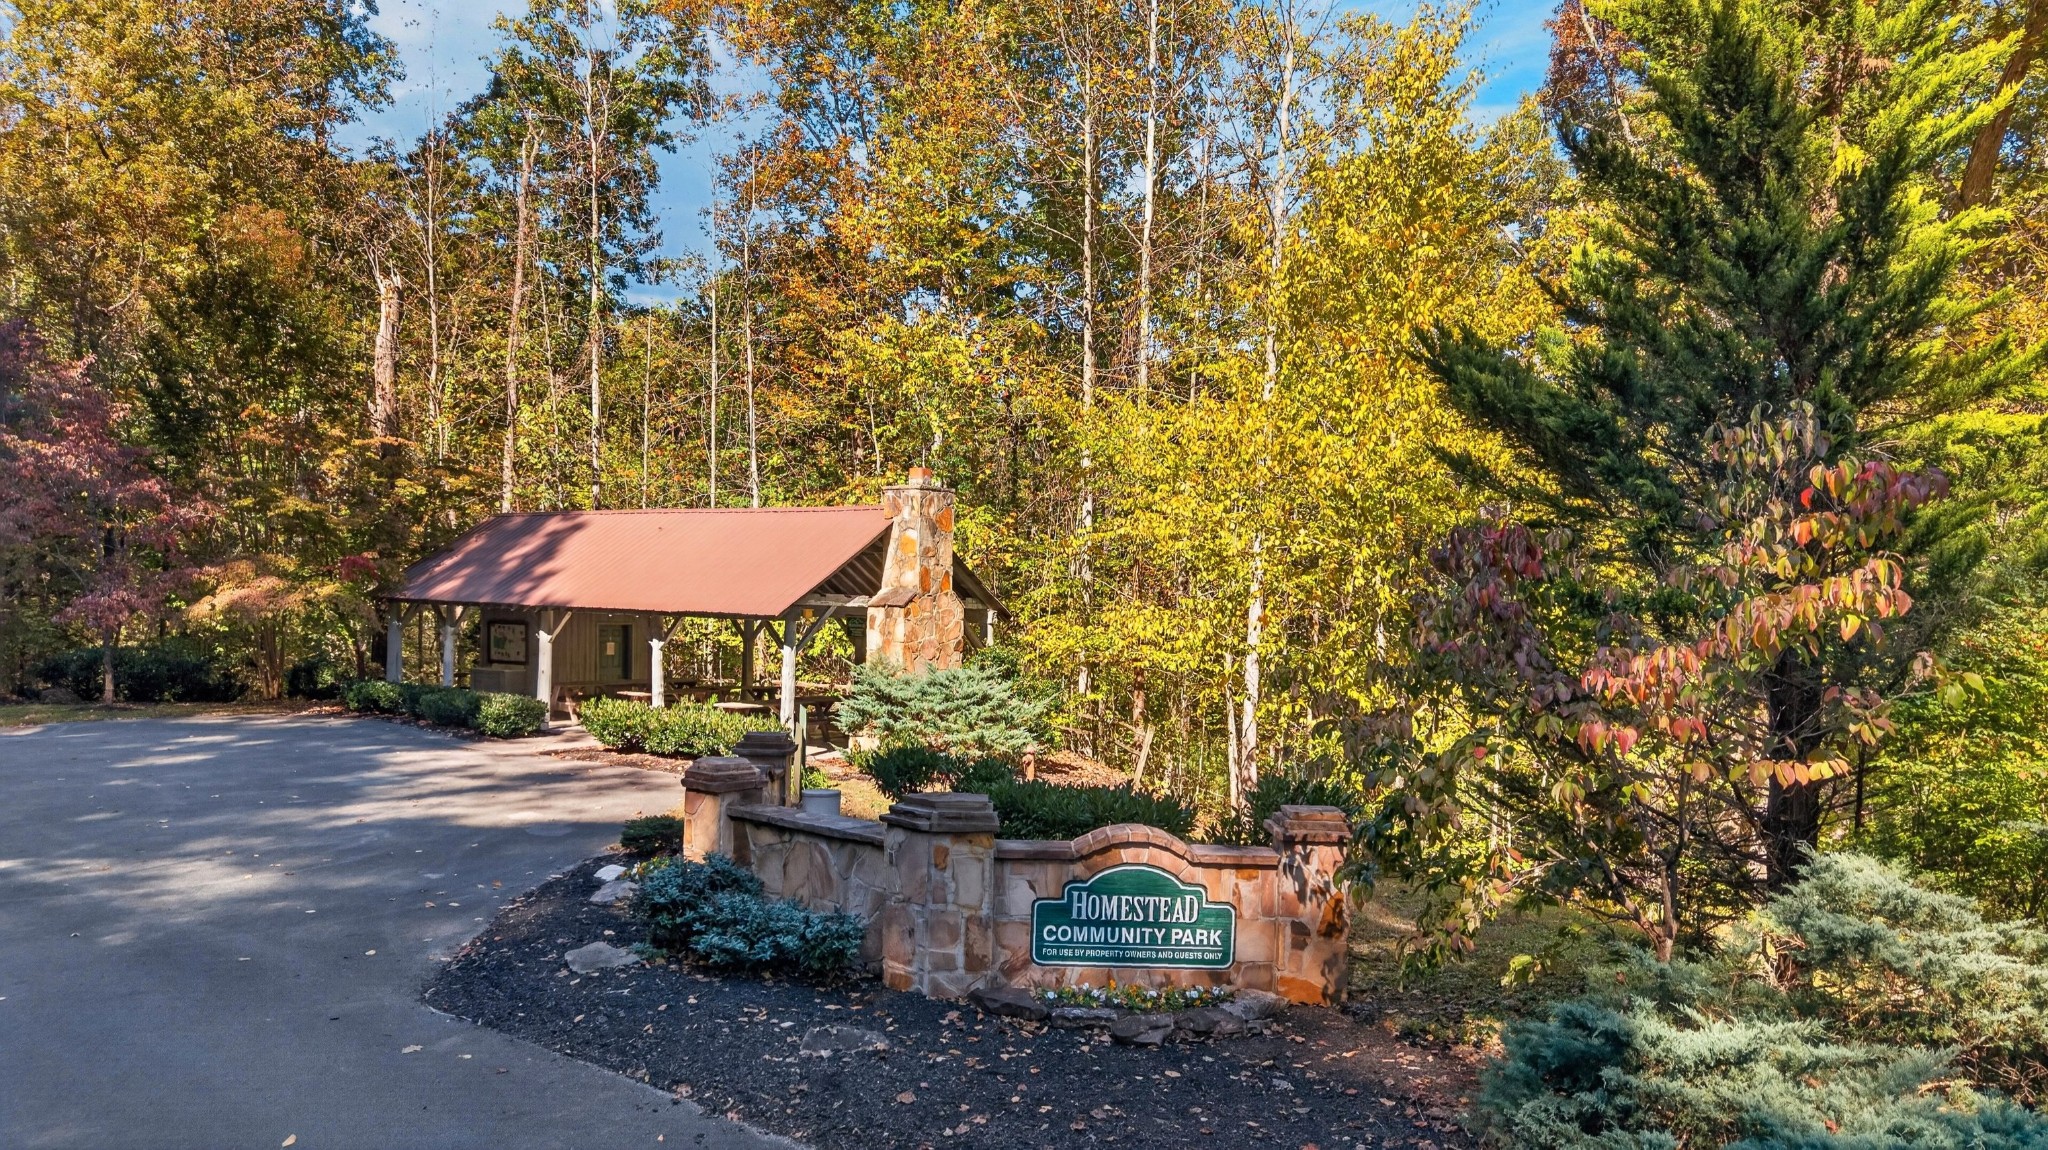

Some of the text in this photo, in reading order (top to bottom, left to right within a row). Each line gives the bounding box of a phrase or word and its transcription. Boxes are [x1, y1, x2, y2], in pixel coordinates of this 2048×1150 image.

[1071, 891, 1199, 924] HOMESTEAD
[1043, 925, 1222, 946] COMMUNITY PARK
[1042, 948, 1223, 960] FOR USE BY PROPERTY OWNERS AND GUESTS ONLY
